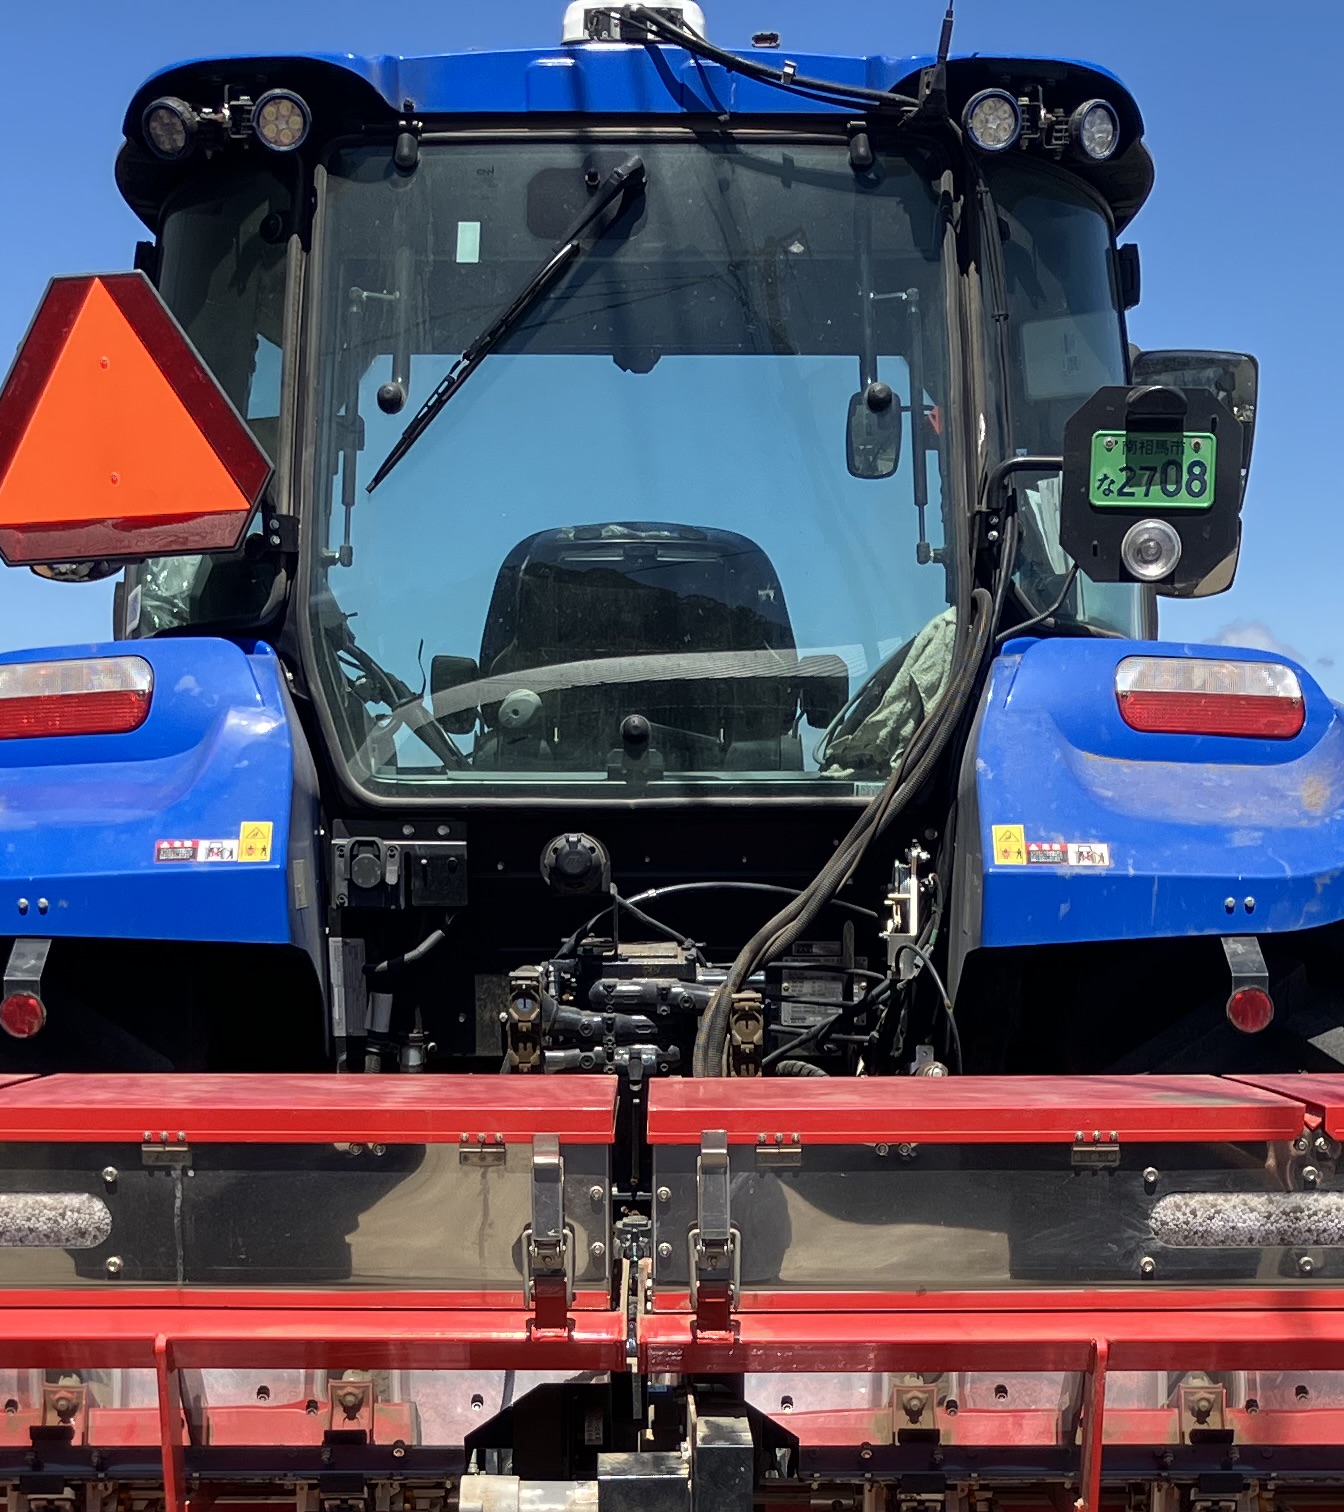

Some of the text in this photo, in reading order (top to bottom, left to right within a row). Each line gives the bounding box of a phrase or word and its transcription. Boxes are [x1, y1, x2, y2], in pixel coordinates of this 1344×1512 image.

[1122, 439, 1185, 456] 南相馬市
[1096, 459, 1207, 498] な 2708
